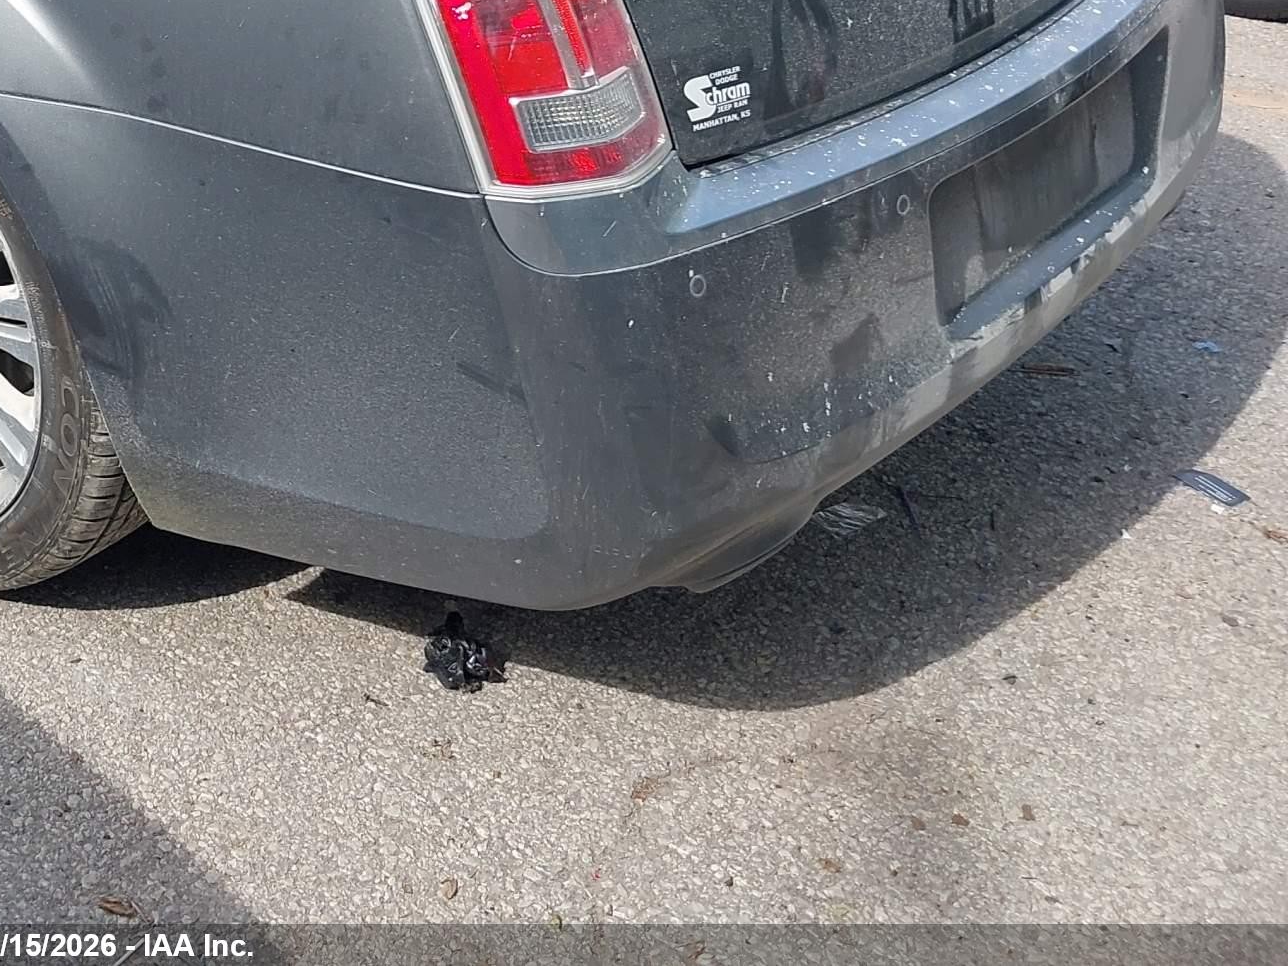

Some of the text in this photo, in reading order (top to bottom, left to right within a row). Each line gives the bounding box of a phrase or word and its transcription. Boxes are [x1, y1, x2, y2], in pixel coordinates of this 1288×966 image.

[709, 65, 741, 79] CHRYSLER
[715, 73, 738, 85] DODGE
[683, 74, 751, 122] Schram
[717, 103, 733, 113] JEEP
[692, 109, 751, 132] MANHATTAN, KS
